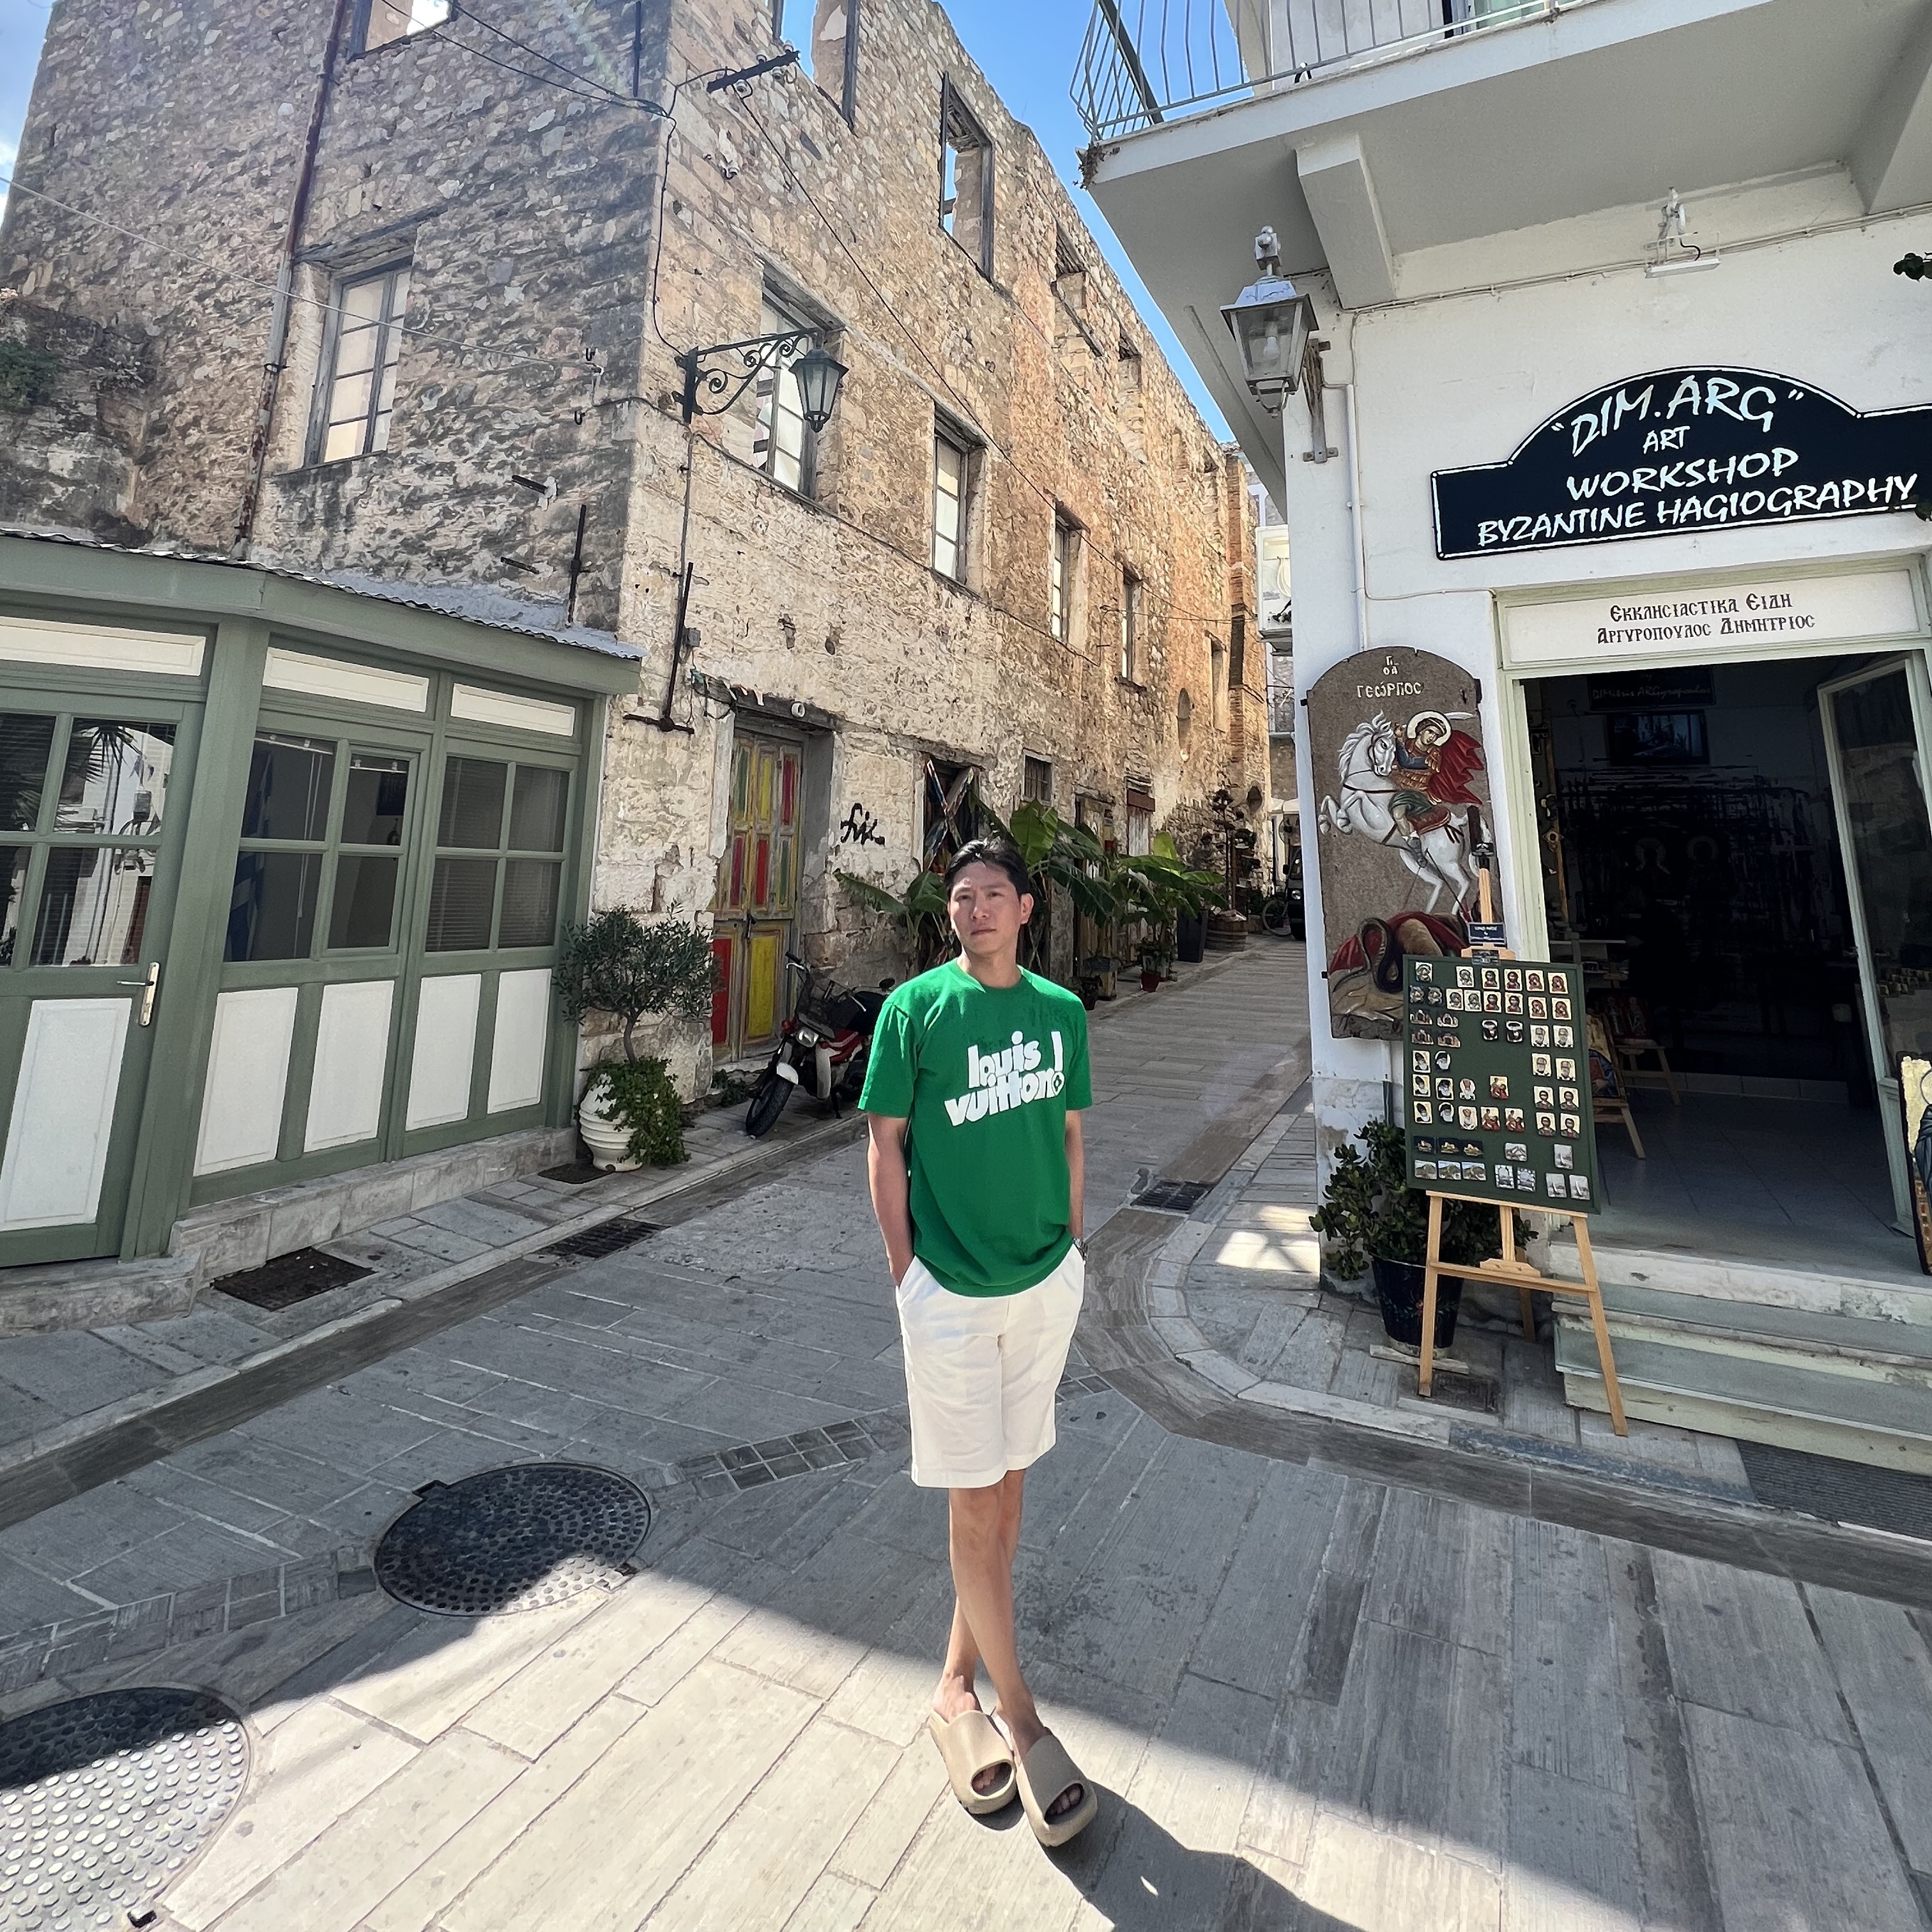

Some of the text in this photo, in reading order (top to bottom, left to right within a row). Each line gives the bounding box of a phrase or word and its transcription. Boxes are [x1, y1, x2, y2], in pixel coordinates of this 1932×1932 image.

[1643, 425, 1690, 454] ART
[1567, 447, 1799, 501] WORKSHOP
[1477, 473, 1918, 547] BYZANTINE HAGIOGRAPHY
[967, 1031, 1042, 1089] louis
